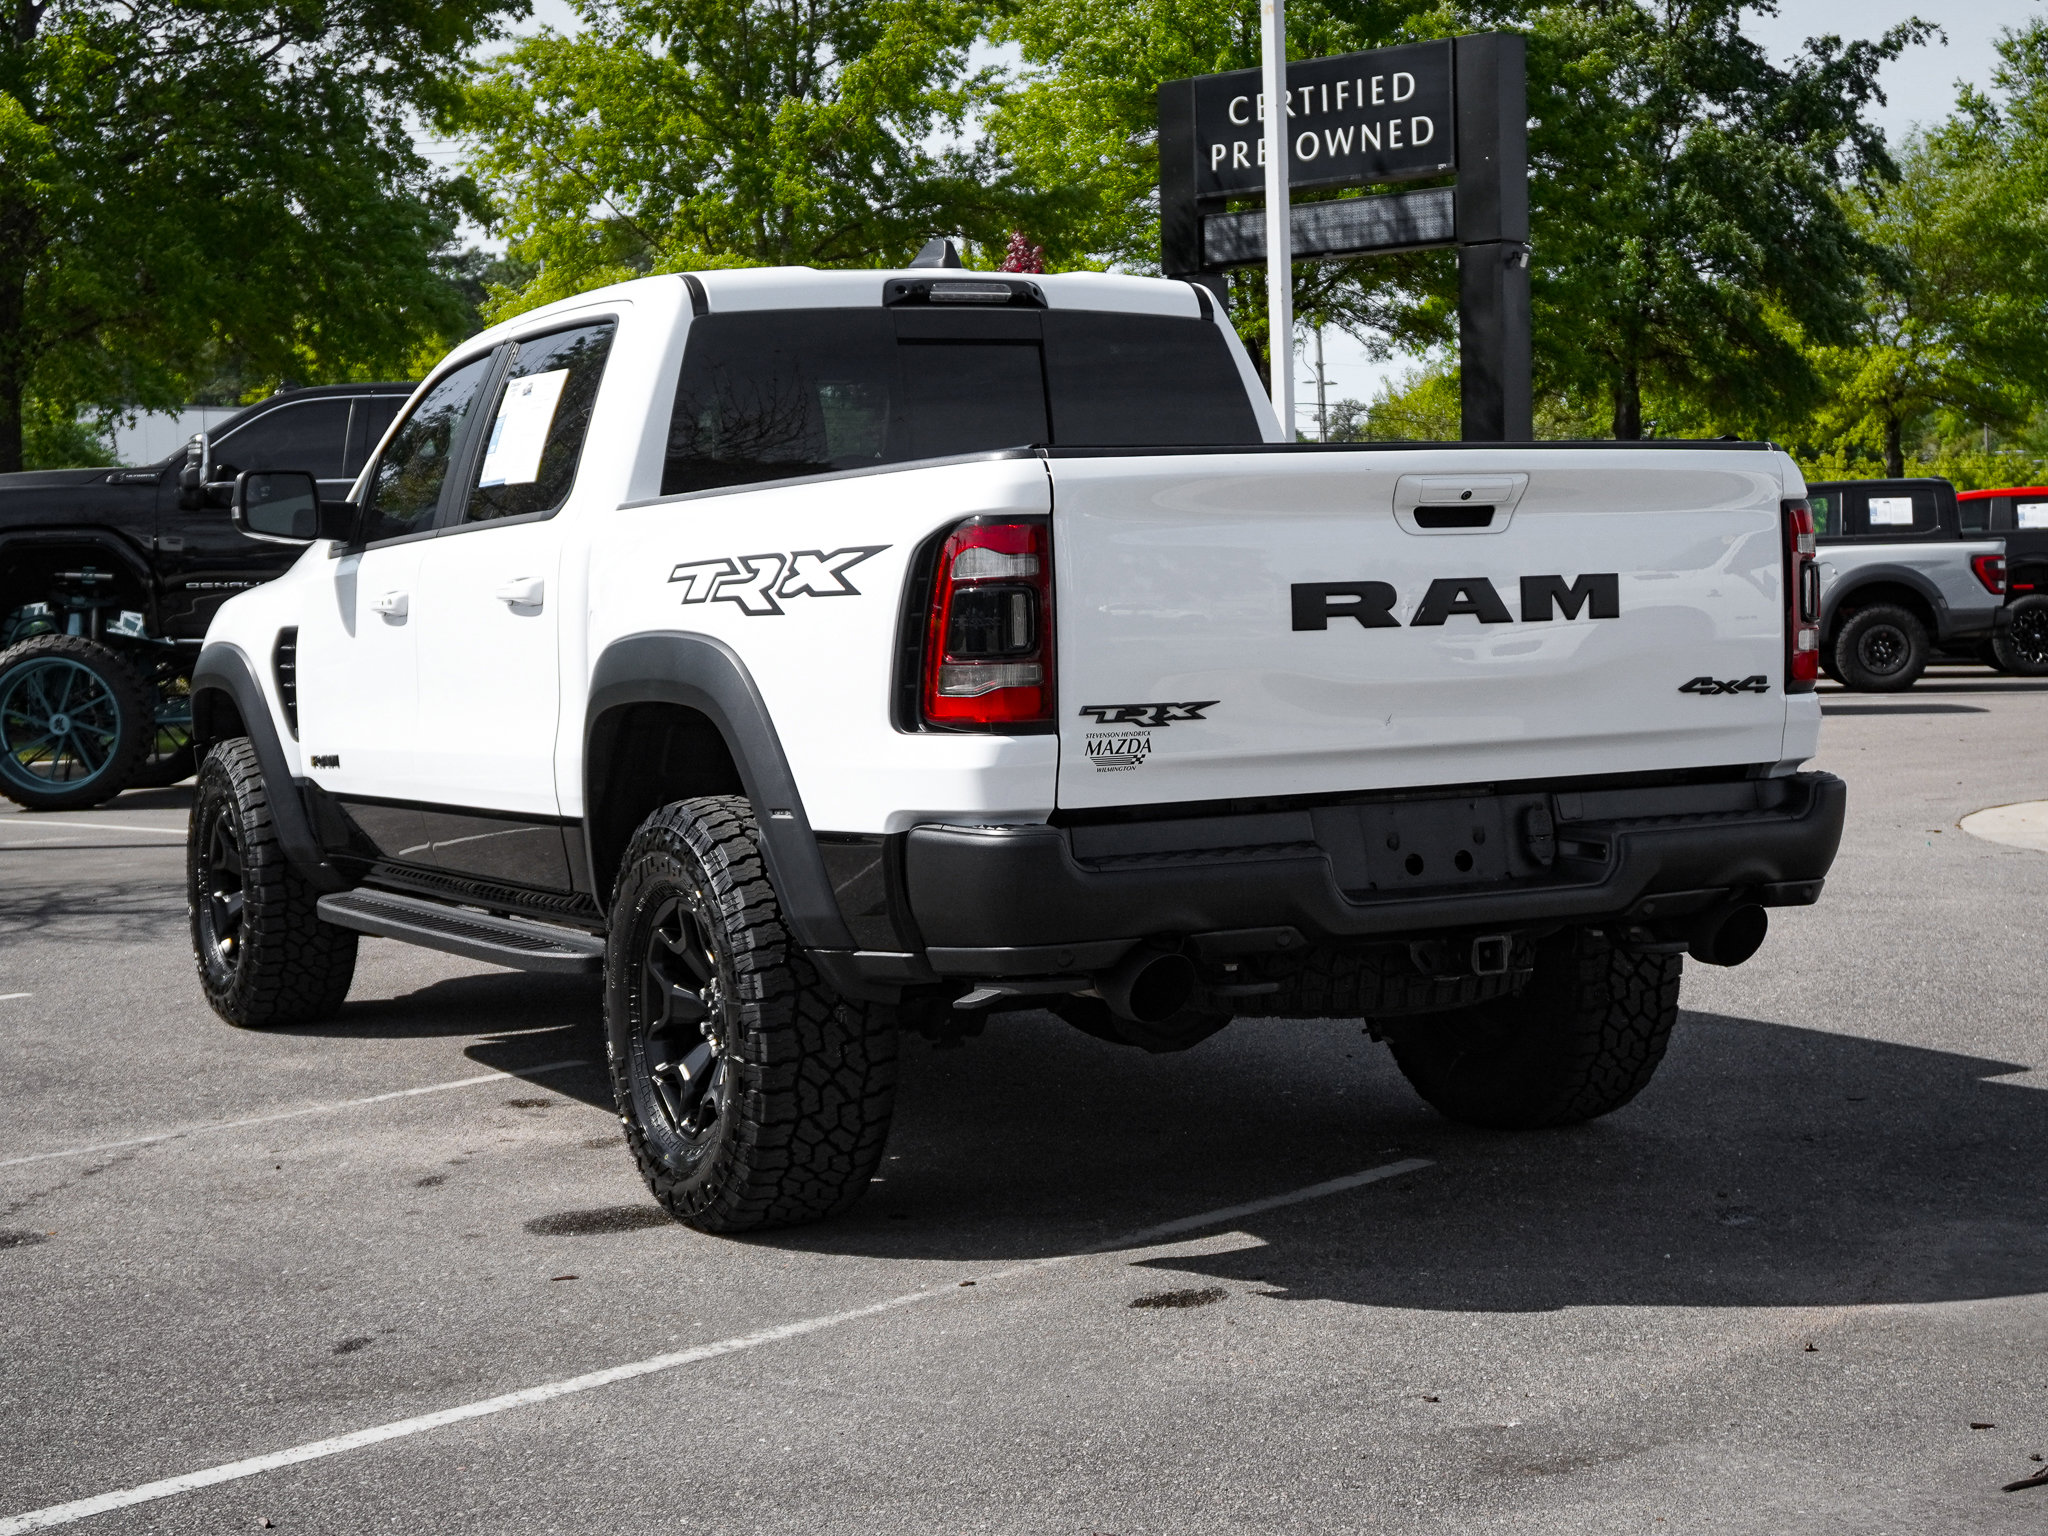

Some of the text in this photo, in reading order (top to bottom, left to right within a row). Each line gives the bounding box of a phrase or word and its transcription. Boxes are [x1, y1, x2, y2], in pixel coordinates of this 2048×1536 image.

[1228, 72, 1416, 125] CERTIFIED
[1295, 115, 1434, 161] OWNED
[667, 544, 894, 616] TRX
[1291, 573, 1620, 631] RAM
[1678, 675, 1771, 695] 4x4
[1079, 700, 1221, 727] TRX
[1085, 730, 1152, 739] STEVENSON HENDRICK
[1085, 738, 1152, 756] MAZDA
[1096, 765, 1137, 773] WILMINGTON
